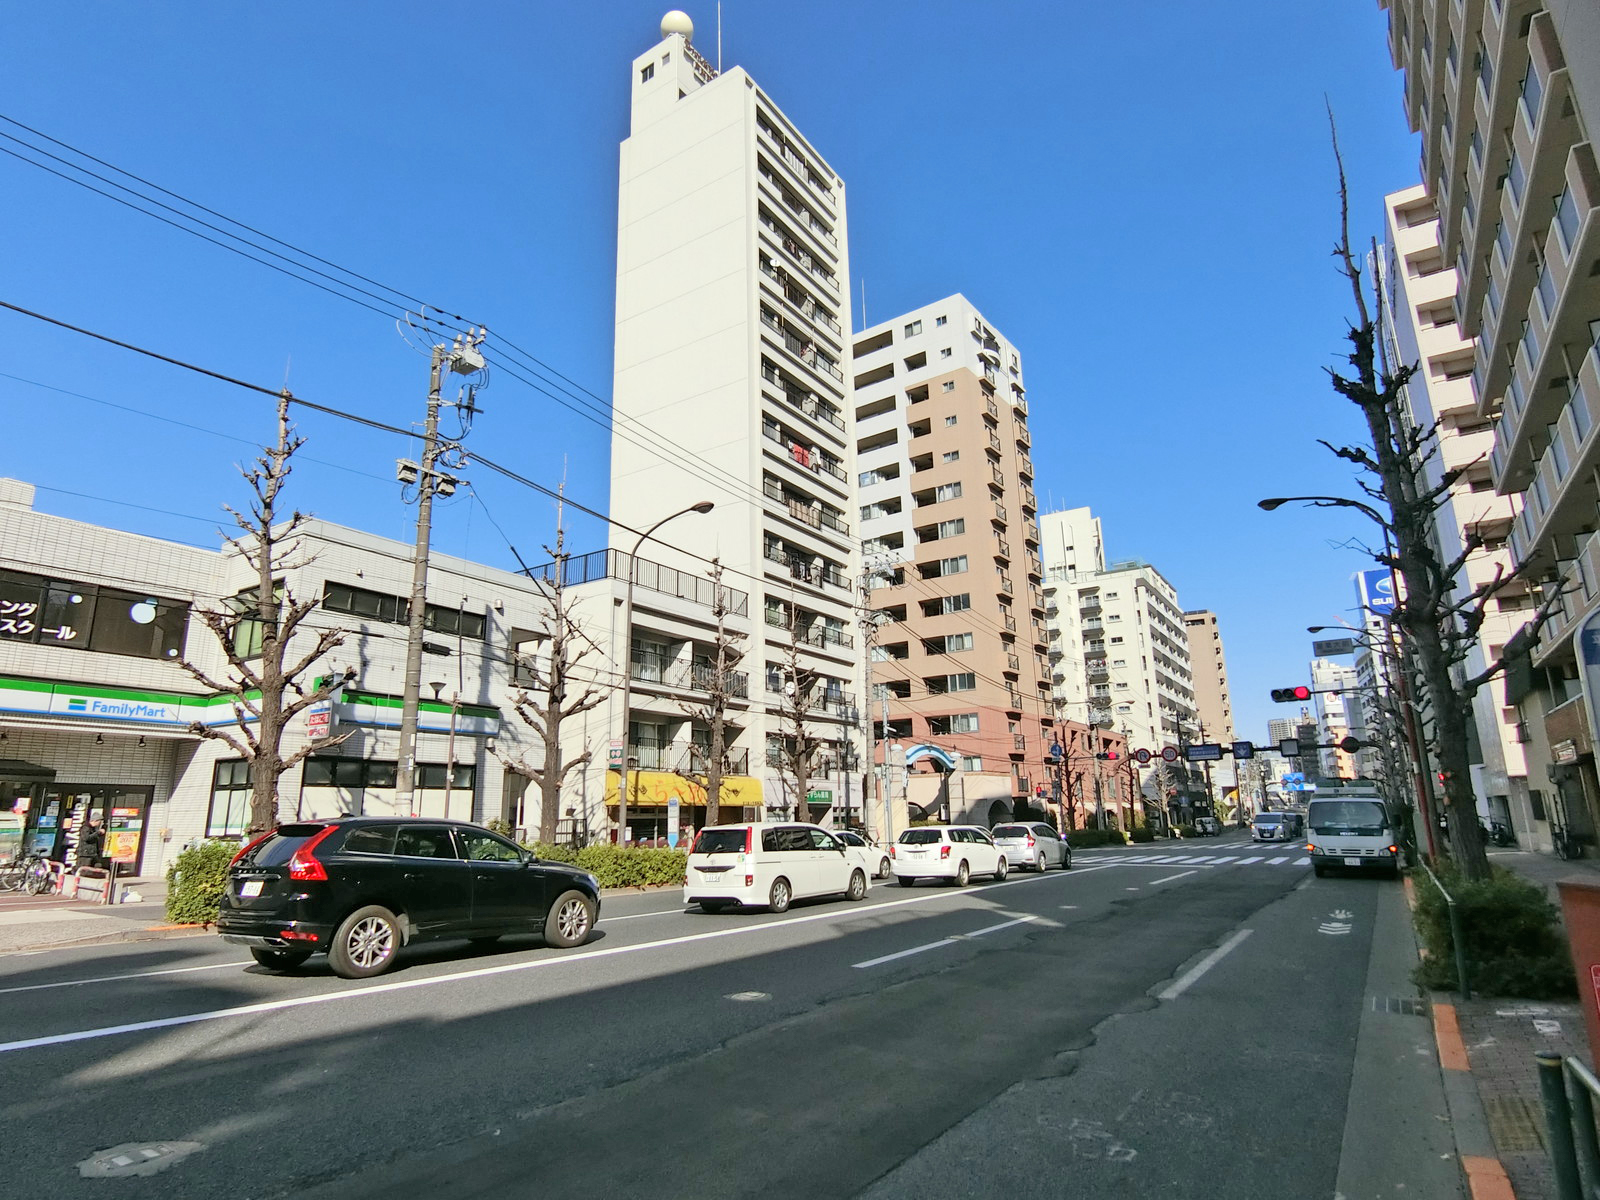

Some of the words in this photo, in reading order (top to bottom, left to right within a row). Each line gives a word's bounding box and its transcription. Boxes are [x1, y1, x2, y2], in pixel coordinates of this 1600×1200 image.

[0, 600, 38, 617] ング
[0, 618, 77, 640] スクール
[92, 701, 166, 717] FamilyMart
[1165, 750, 1174, 758] 50
